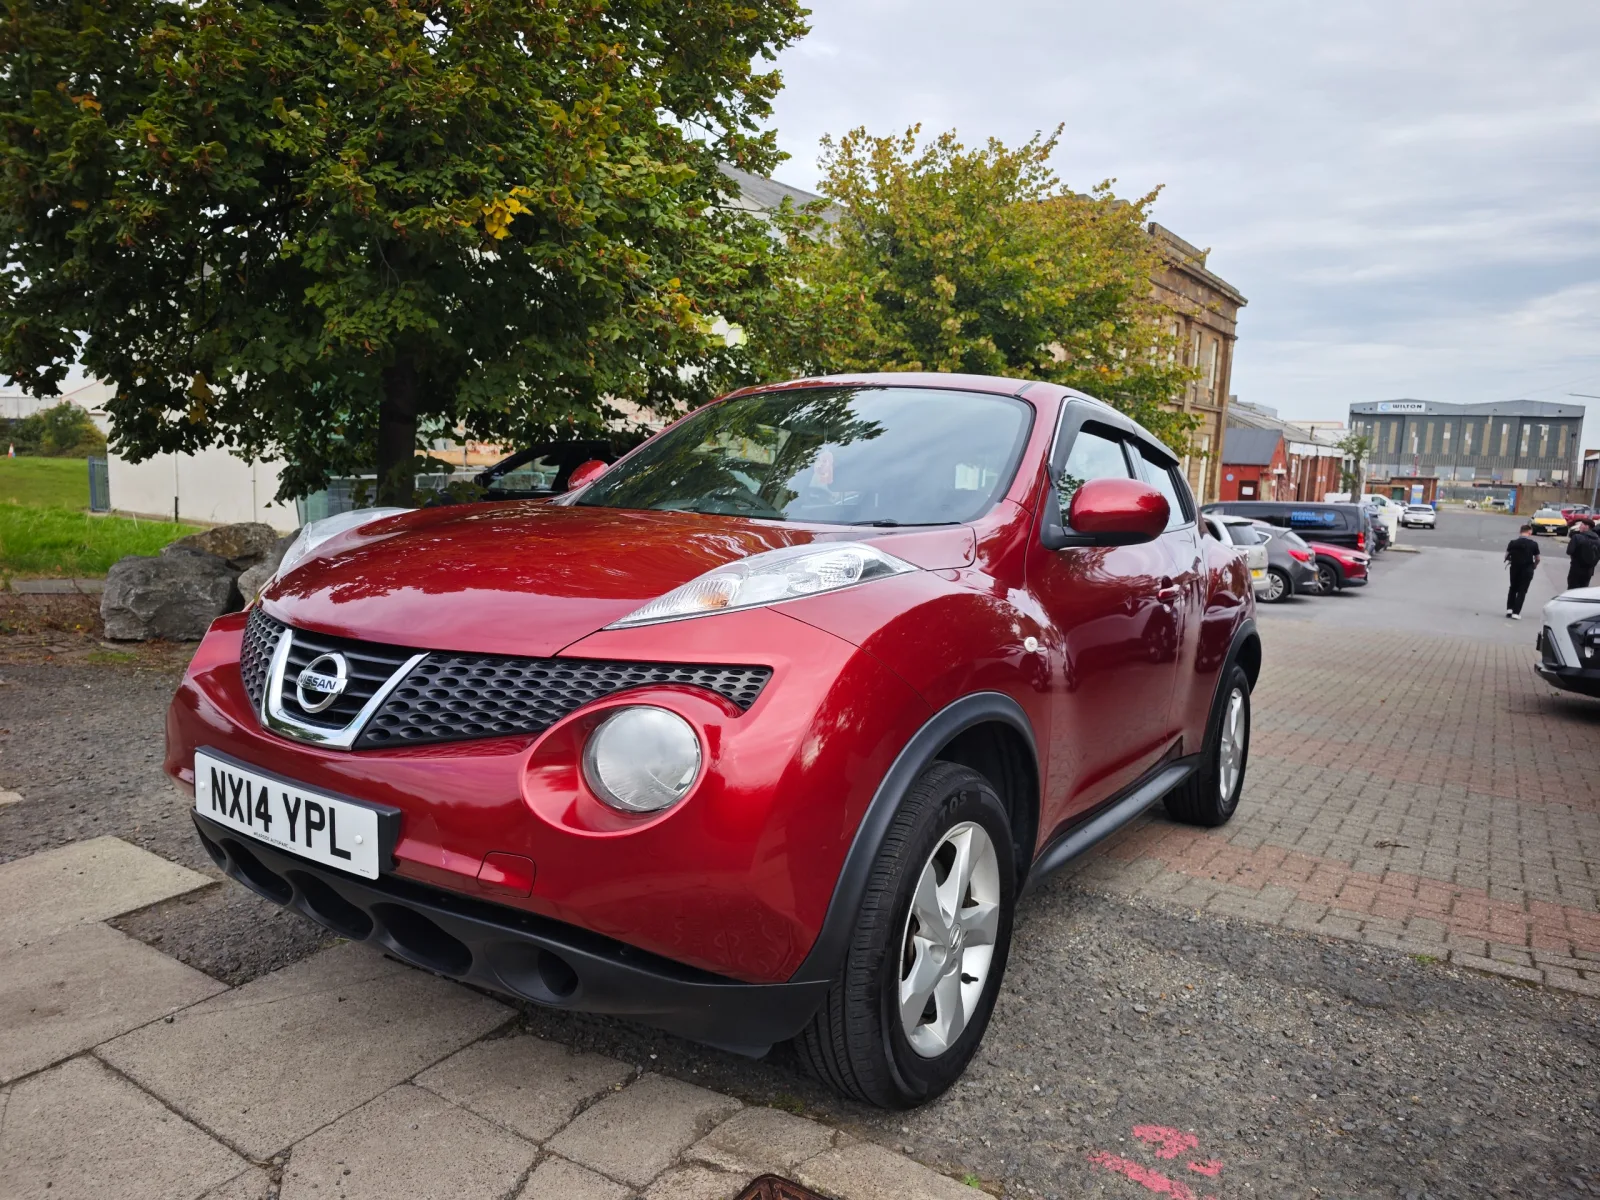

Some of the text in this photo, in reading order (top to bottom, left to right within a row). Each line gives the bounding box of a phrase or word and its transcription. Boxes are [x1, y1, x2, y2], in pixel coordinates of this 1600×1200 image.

[299, 673, 337, 690] NISSAN
[211, 766, 351, 861] NX14 YPL
